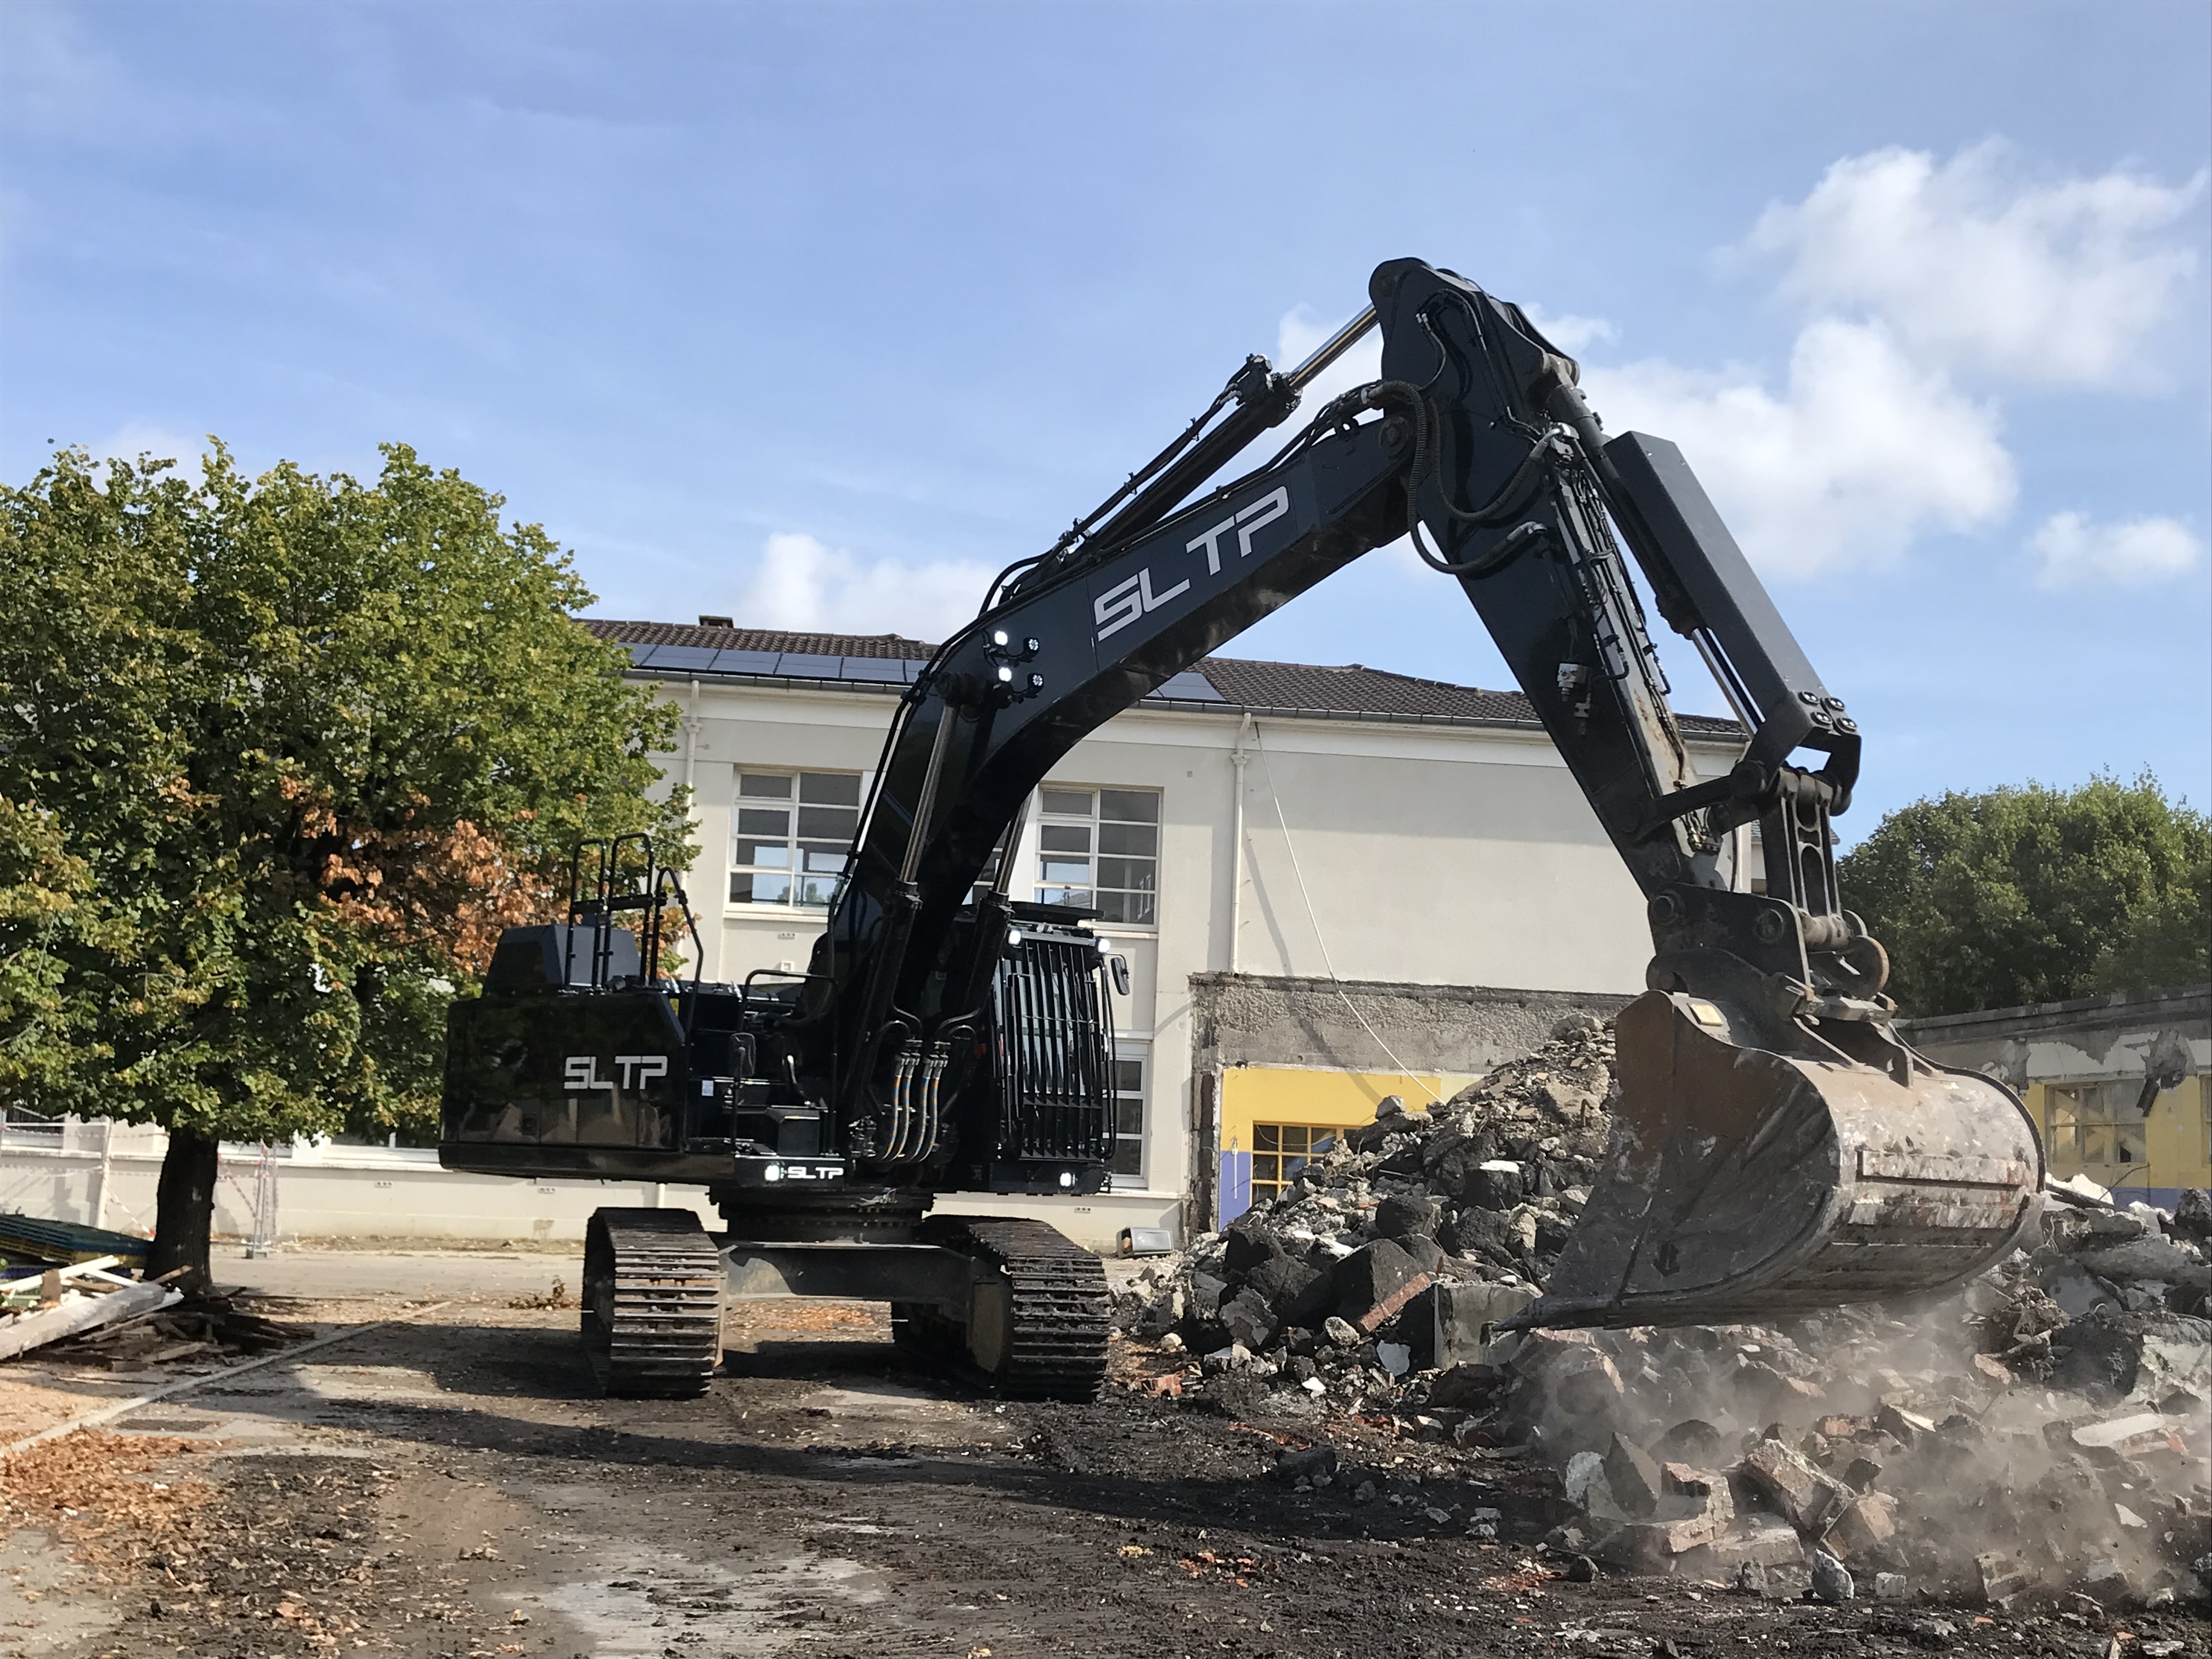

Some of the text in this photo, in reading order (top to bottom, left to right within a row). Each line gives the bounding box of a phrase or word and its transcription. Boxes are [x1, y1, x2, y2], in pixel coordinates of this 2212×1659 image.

[1094, 486, 1289, 642] SLTP
[564, 1056, 668, 1090] SLTP
[787, 1166, 844, 1180] SLTP
